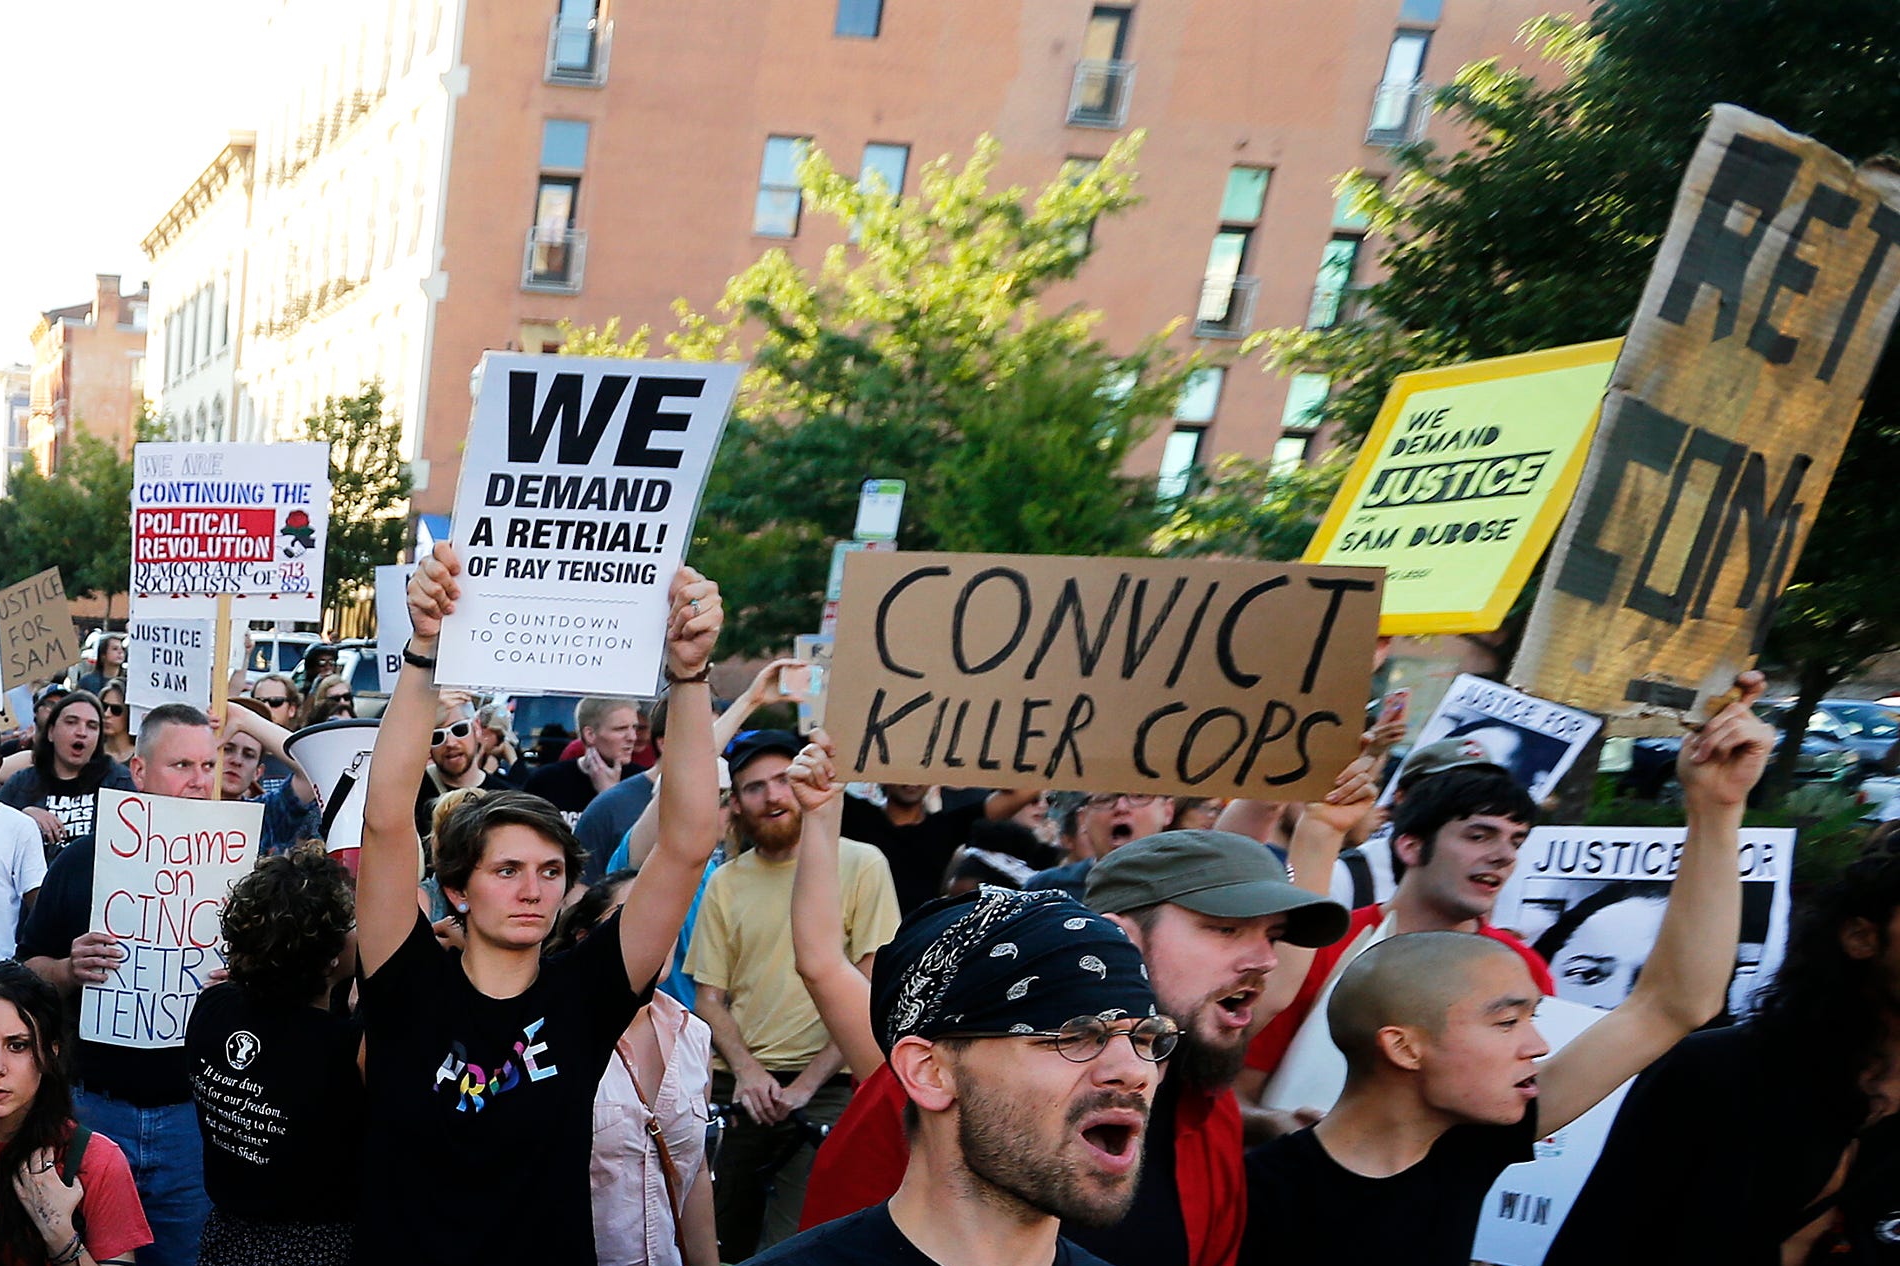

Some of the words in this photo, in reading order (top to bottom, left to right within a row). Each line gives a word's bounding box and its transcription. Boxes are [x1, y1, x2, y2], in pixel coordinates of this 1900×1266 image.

[507, 370, 707, 469] WE
[1407, 407, 1452, 432] WE
[1389, 425, 1502, 458] DEMAND
[139, 454, 173, 477] WE
[181, 452, 223, 476] ARE
[139, 481, 265, 504] CONTINUING
[271, 482, 312, 504] THE
[483, 472, 673, 513] DEMAND
[1363, 455, 1550, 507] JUSTICE
[138, 512, 247, 535] POLITICAL
[468, 517, 494, 547] A
[505, 518, 669, 554] RETRIAL!
[1340, 527, 1402, 552] SAM
[1407, 517, 1520, 548] DUBOSE
[137, 536, 271, 560] REVOLUTION
[134, 561, 254, 578] DEMOCRATIC
[253, 569, 278, 586] OF
[467, 555, 499, 578] OF
[504, 558, 553, 580] RAY
[556, 560, 658, 585] TENSING
[134, 576, 242, 594] SOCIALISTS
[280, 575, 311, 593] 859
[8, 614, 52, 648] FOR
[488, 611, 620, 631] COUNTDOWN
[874, 564, 1377, 695] CONVICT
[130, 623, 202, 649] JUSTICE
[470, 629, 498, 645] TO
[503, 630, 633, 650] CONVICTION
[11, 637, 67, 678] SAM
[151, 646, 185, 668] FOR
[493, 648, 604, 667] COALITION
[150, 671, 188, 692] SAM
[853, 687, 1096, 780] KILLER
[1132, 698, 1344, 787] COPS
[46, 793, 95, 810] LACK
[110, 796, 247, 865] Shame
[1533, 840, 1685, 876] JUSTICE
[1739, 842, 1777, 877] OR
[154, 869, 195, 897] on
[104, 890, 230, 949] CINC
[84, 986, 201, 1041] TENSI
[212, 1070, 223, 1082] is
[221, 1075, 238, 1088] our
[238, 1077, 265, 1098] duty
[223, 1093, 242, 1107] our
[254, 1117, 265, 1131] to
[267, 1119, 287, 1136] lose
